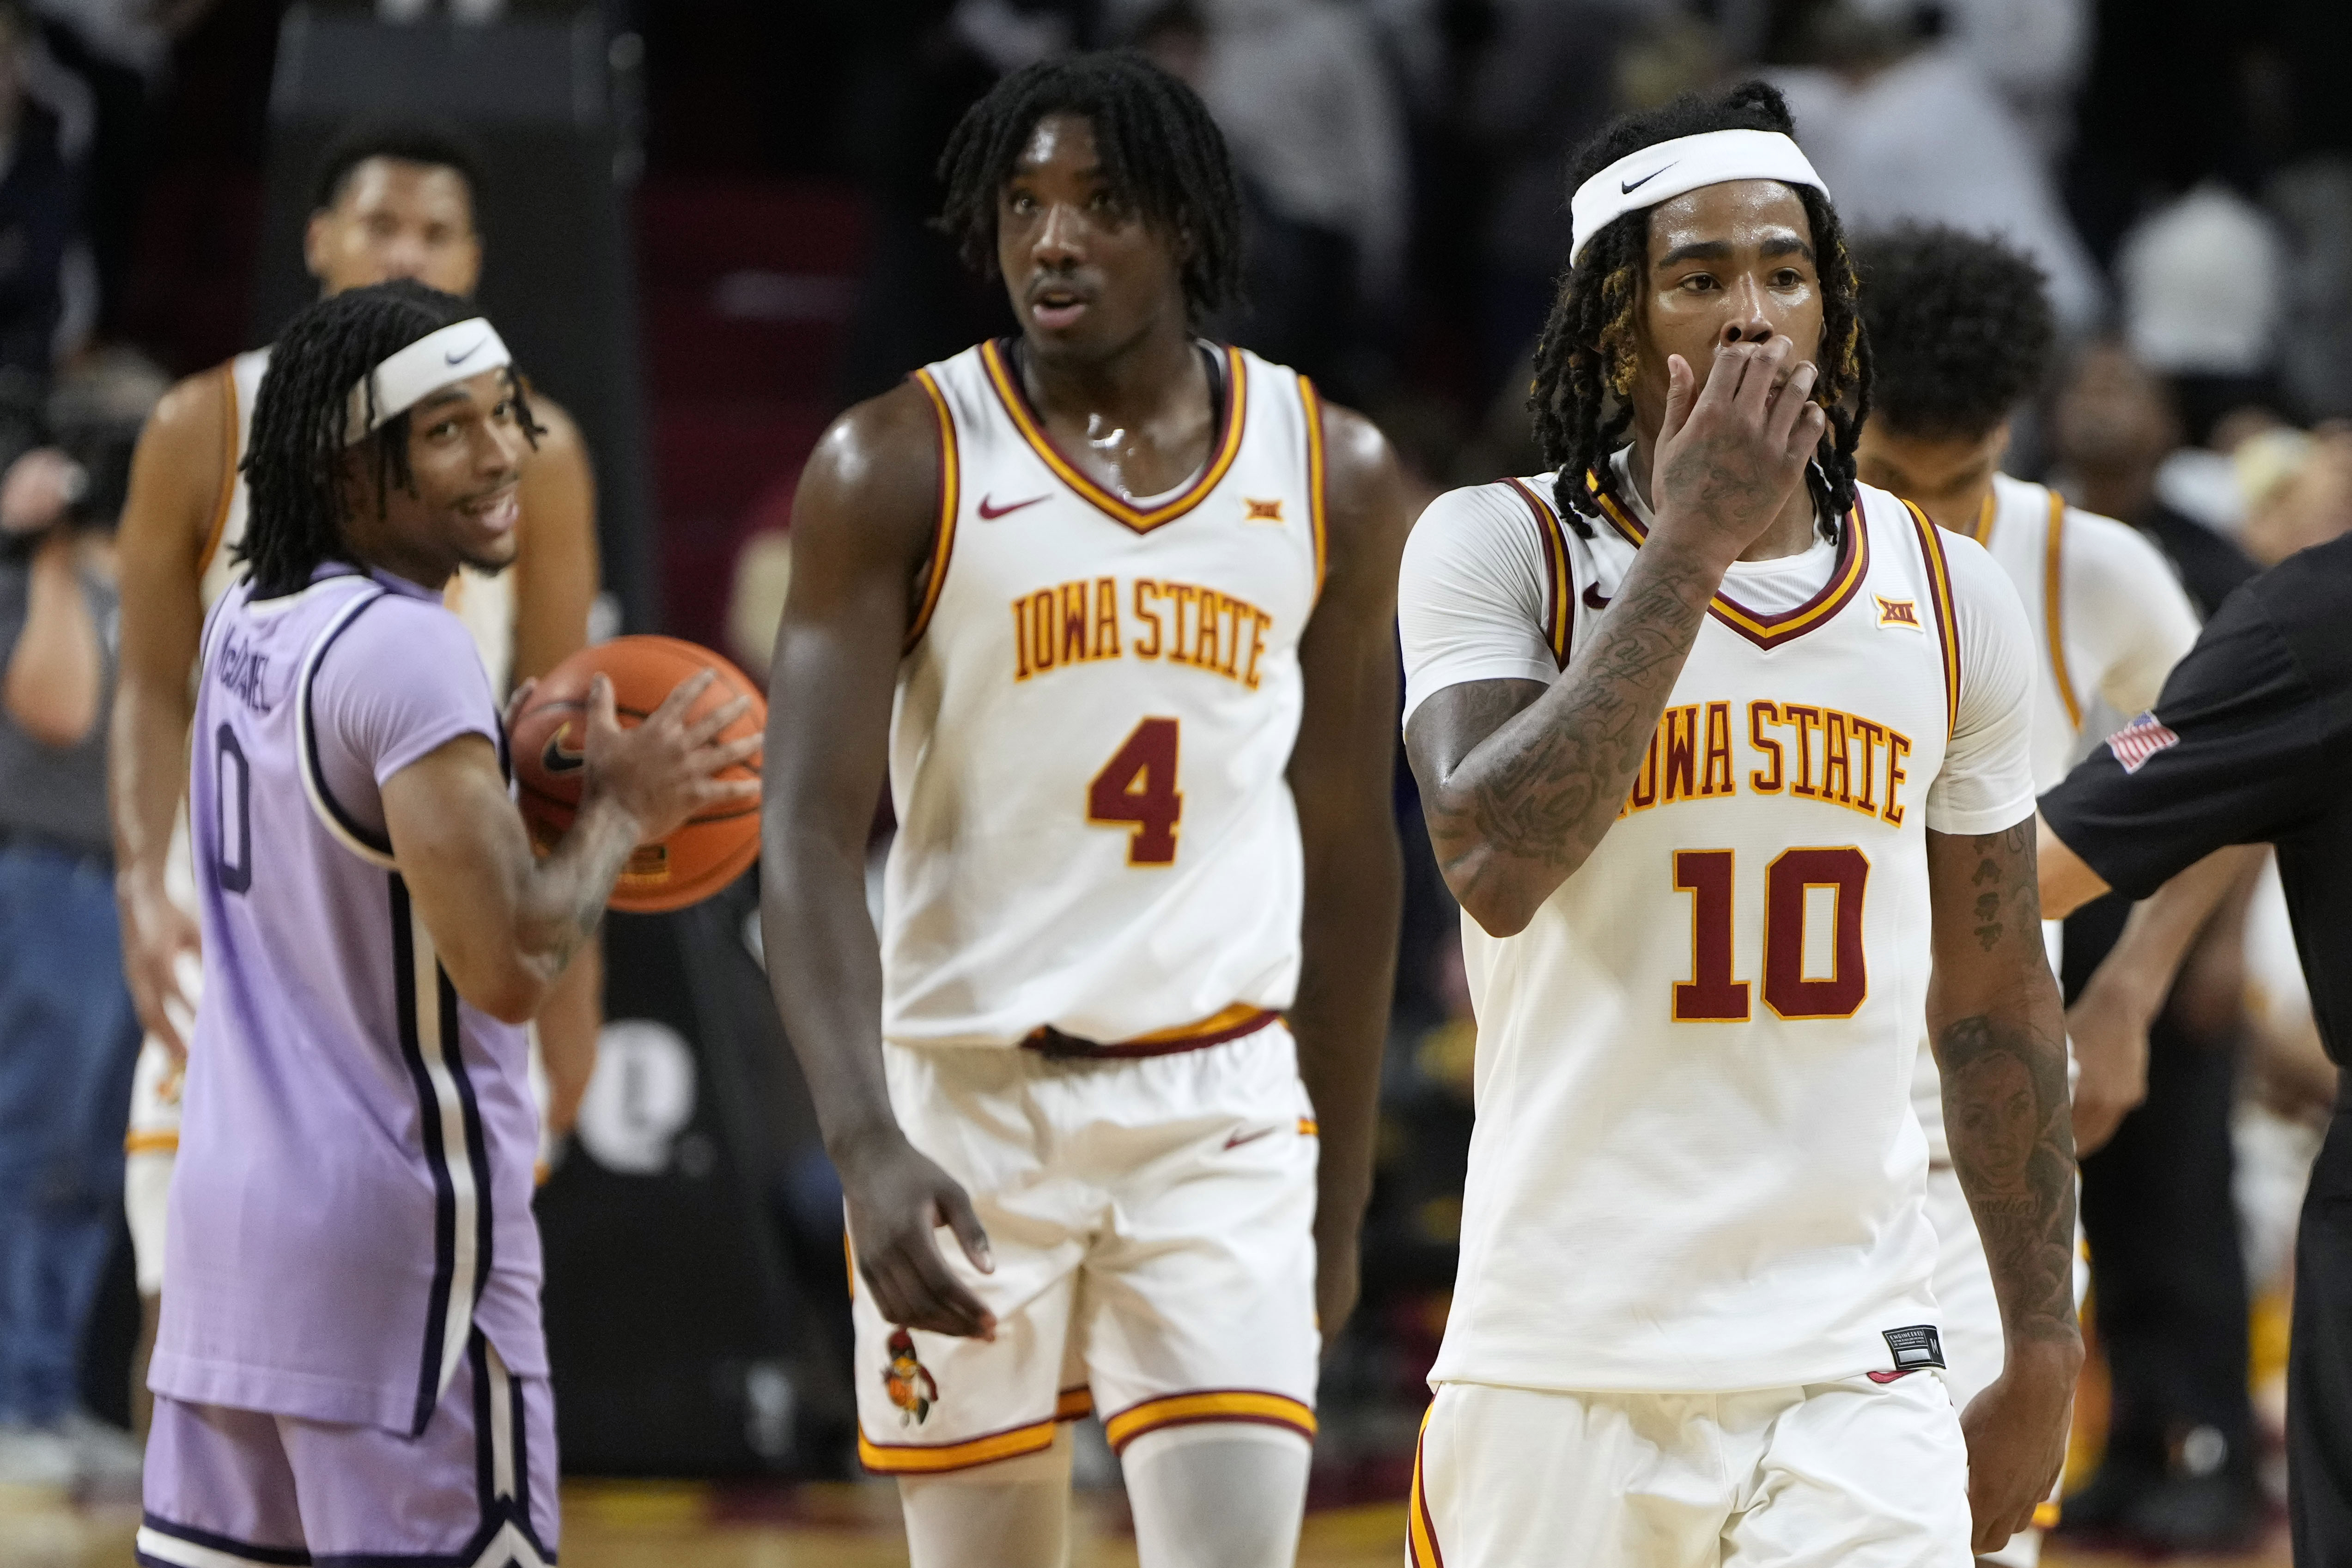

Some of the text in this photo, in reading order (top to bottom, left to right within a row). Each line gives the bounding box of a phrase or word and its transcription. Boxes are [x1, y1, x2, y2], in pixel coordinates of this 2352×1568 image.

[1012, 577, 1271, 690] IOWA STATE
[1876, 596, 1920, 627] XII
[216, 722, 252, 895] 0
[1085, 715, 1184, 868] 4
[1617, 699, 1912, 828] OWA STATE
[1671, 845, 1871, 1023] 10
[1889, 1331, 1923, 1340] ENGINEERED
[1930, 1338, 1939, 1355] M
